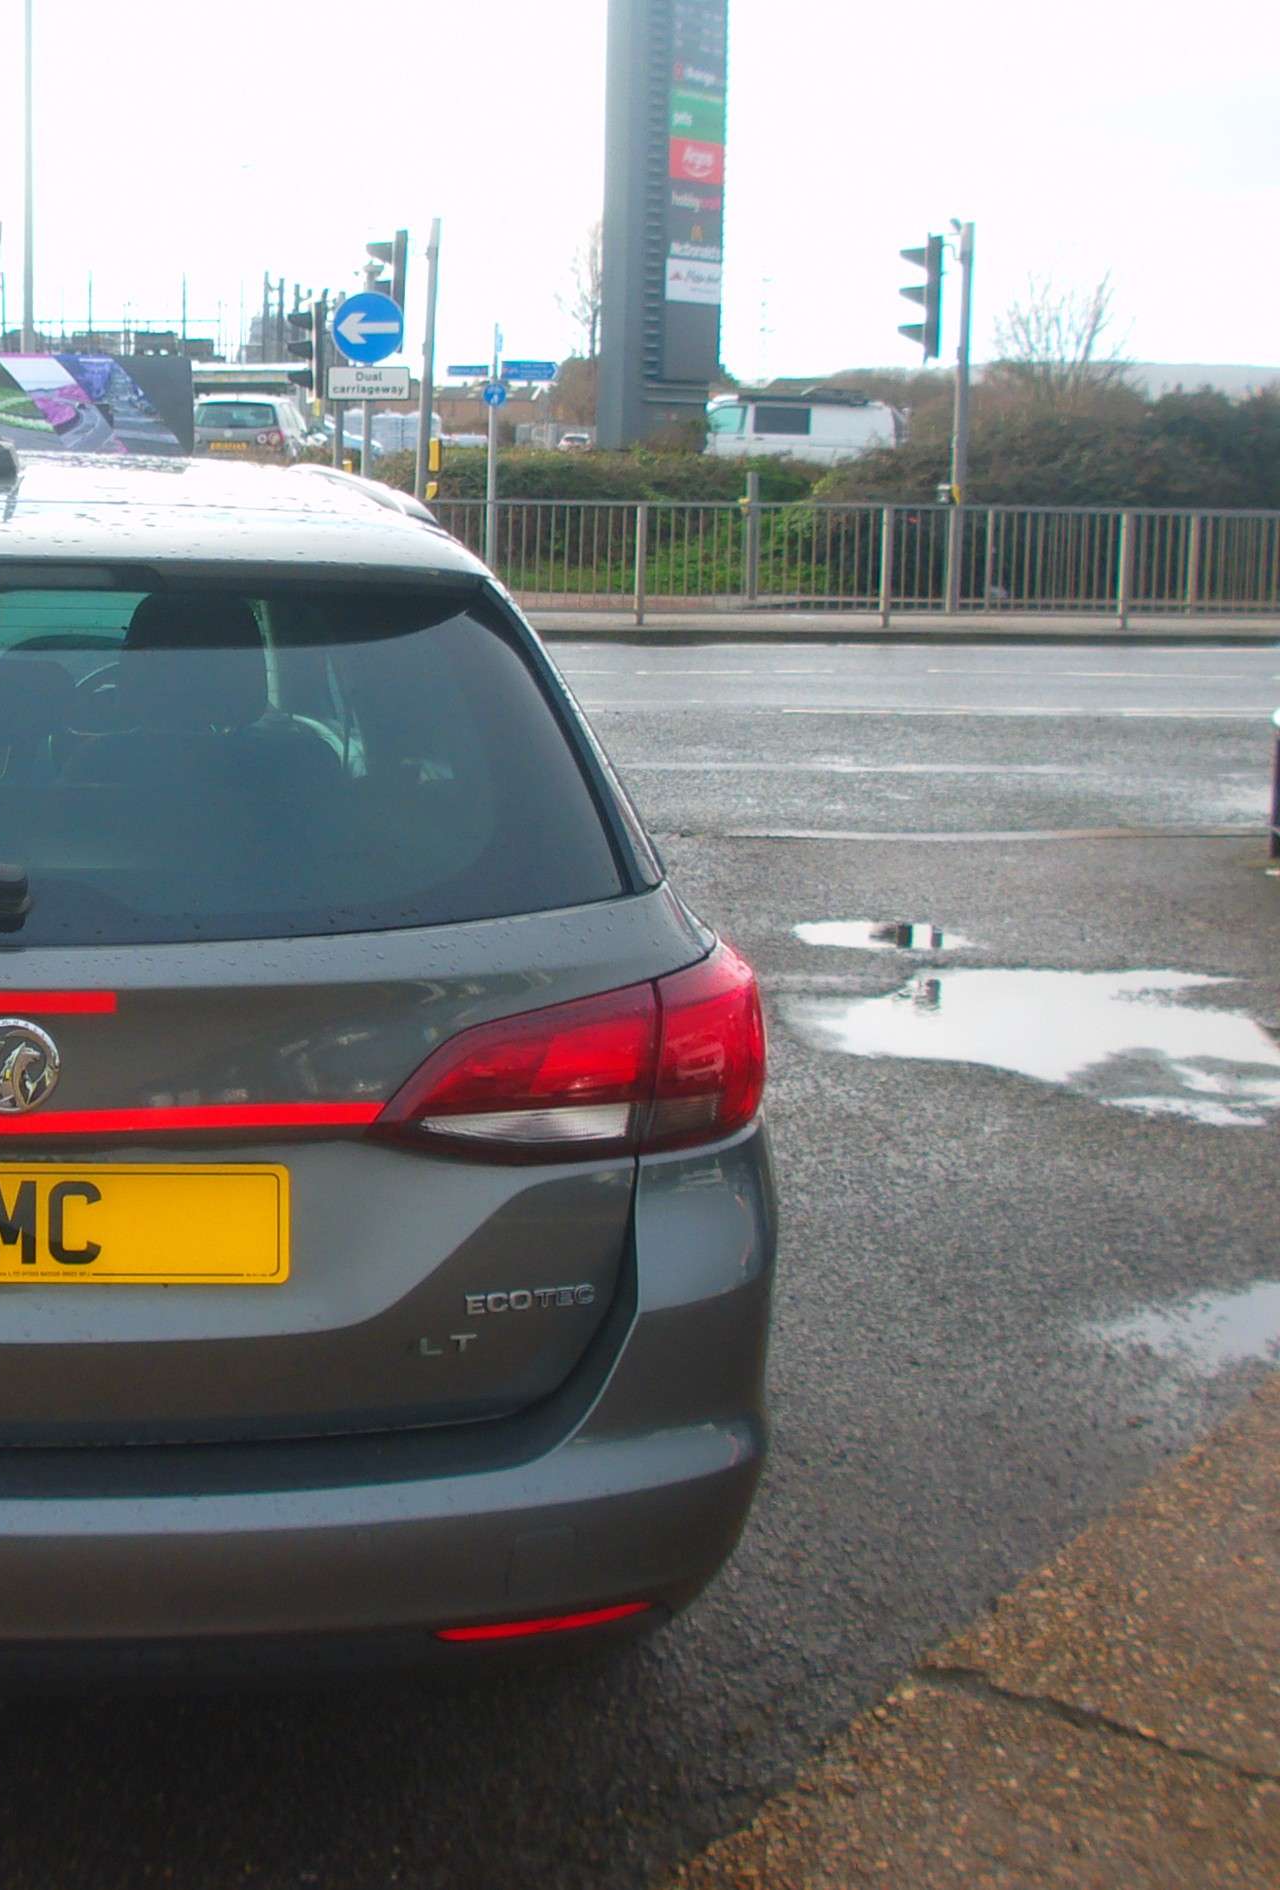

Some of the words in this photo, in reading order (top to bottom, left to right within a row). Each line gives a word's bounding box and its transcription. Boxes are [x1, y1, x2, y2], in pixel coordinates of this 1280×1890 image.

[355, 371, 382, 382] Dual
[332, 385, 405, 396] carriageway
[465, 1284, 595, 1315] ECOTEC
